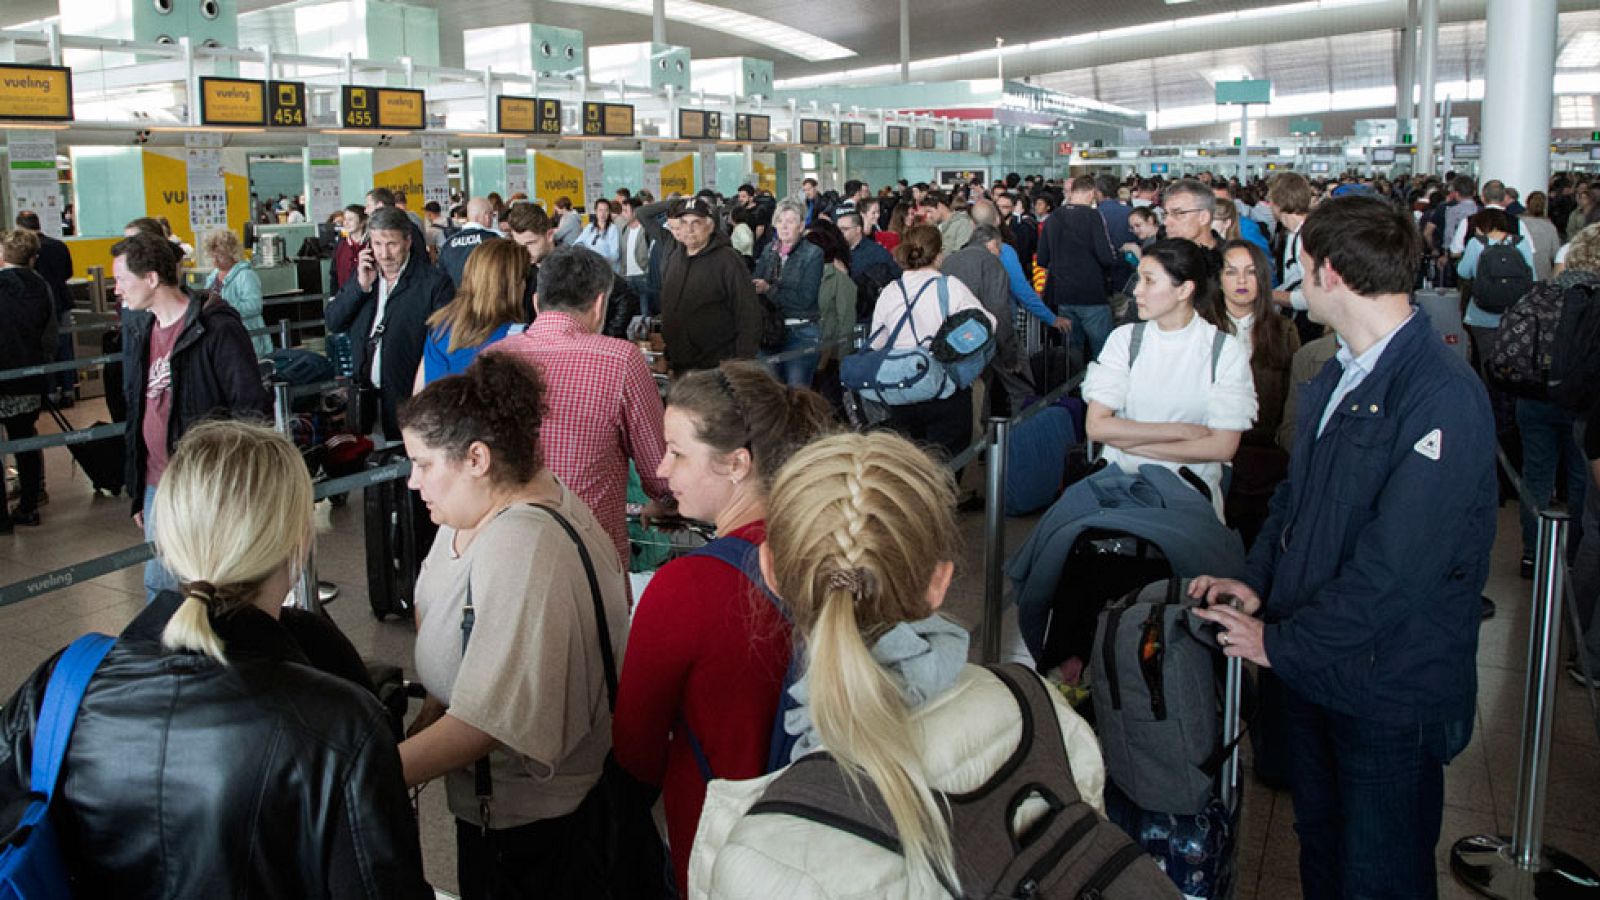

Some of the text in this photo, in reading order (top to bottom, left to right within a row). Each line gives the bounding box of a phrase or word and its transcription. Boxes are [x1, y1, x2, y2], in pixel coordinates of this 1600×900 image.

[4, 75, 50, 93] vueling
[216, 86, 250, 102] vueling
[274, 108, 303, 124] 454
[347, 110, 372, 126] 455
[544, 175, 579, 194] vueling
[27, 572, 73, 593] vueling
